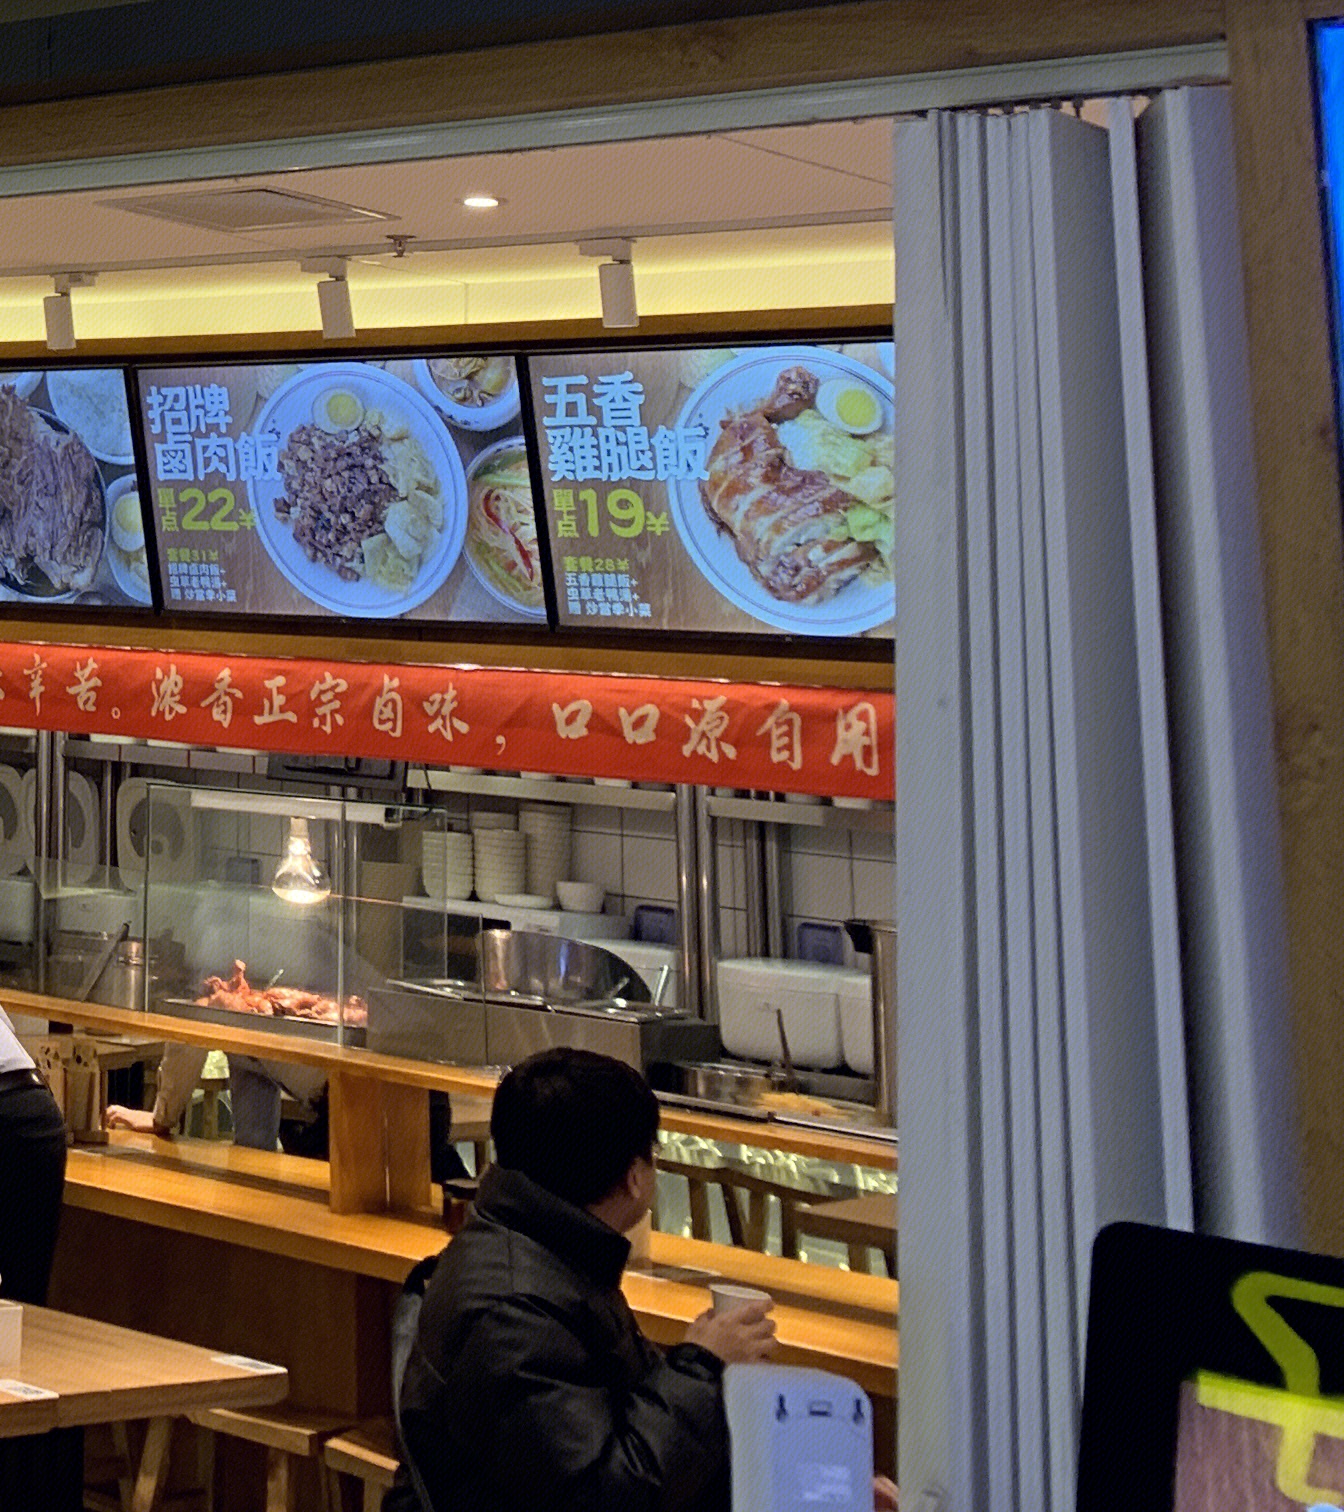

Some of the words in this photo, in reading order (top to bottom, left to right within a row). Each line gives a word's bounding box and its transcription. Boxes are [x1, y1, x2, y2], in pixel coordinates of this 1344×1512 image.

[146, 383, 233, 434] 招牌
[541, 370, 646, 429] 五香
[545, 425, 711, 484] 雞腿飯
